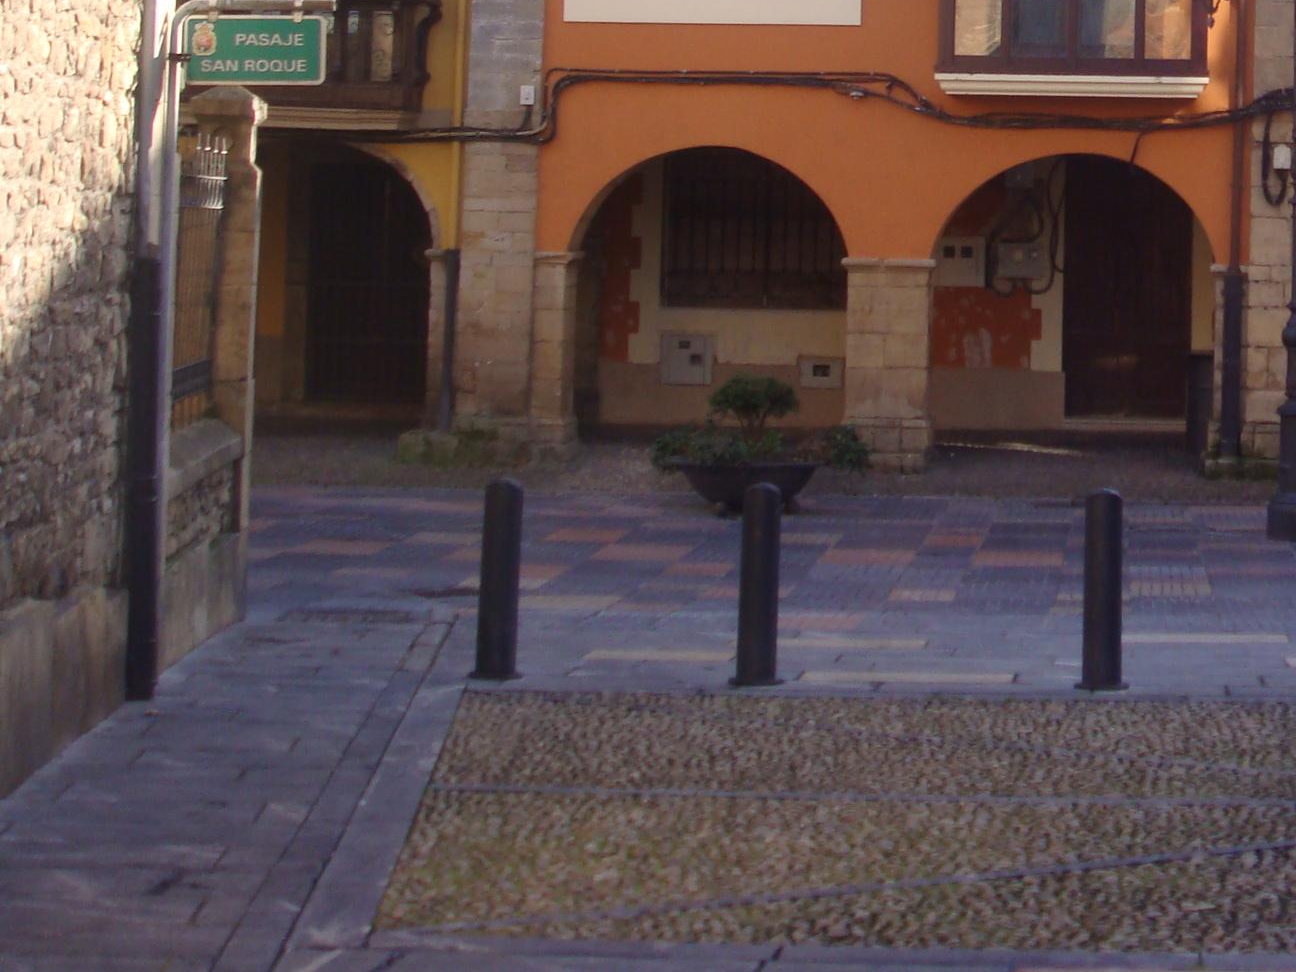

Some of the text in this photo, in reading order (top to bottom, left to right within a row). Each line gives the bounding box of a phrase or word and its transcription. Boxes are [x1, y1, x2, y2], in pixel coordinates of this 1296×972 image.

[235, 34, 305, 46] PASAJE
[201, 59, 307, 72] SAN ROQUE
